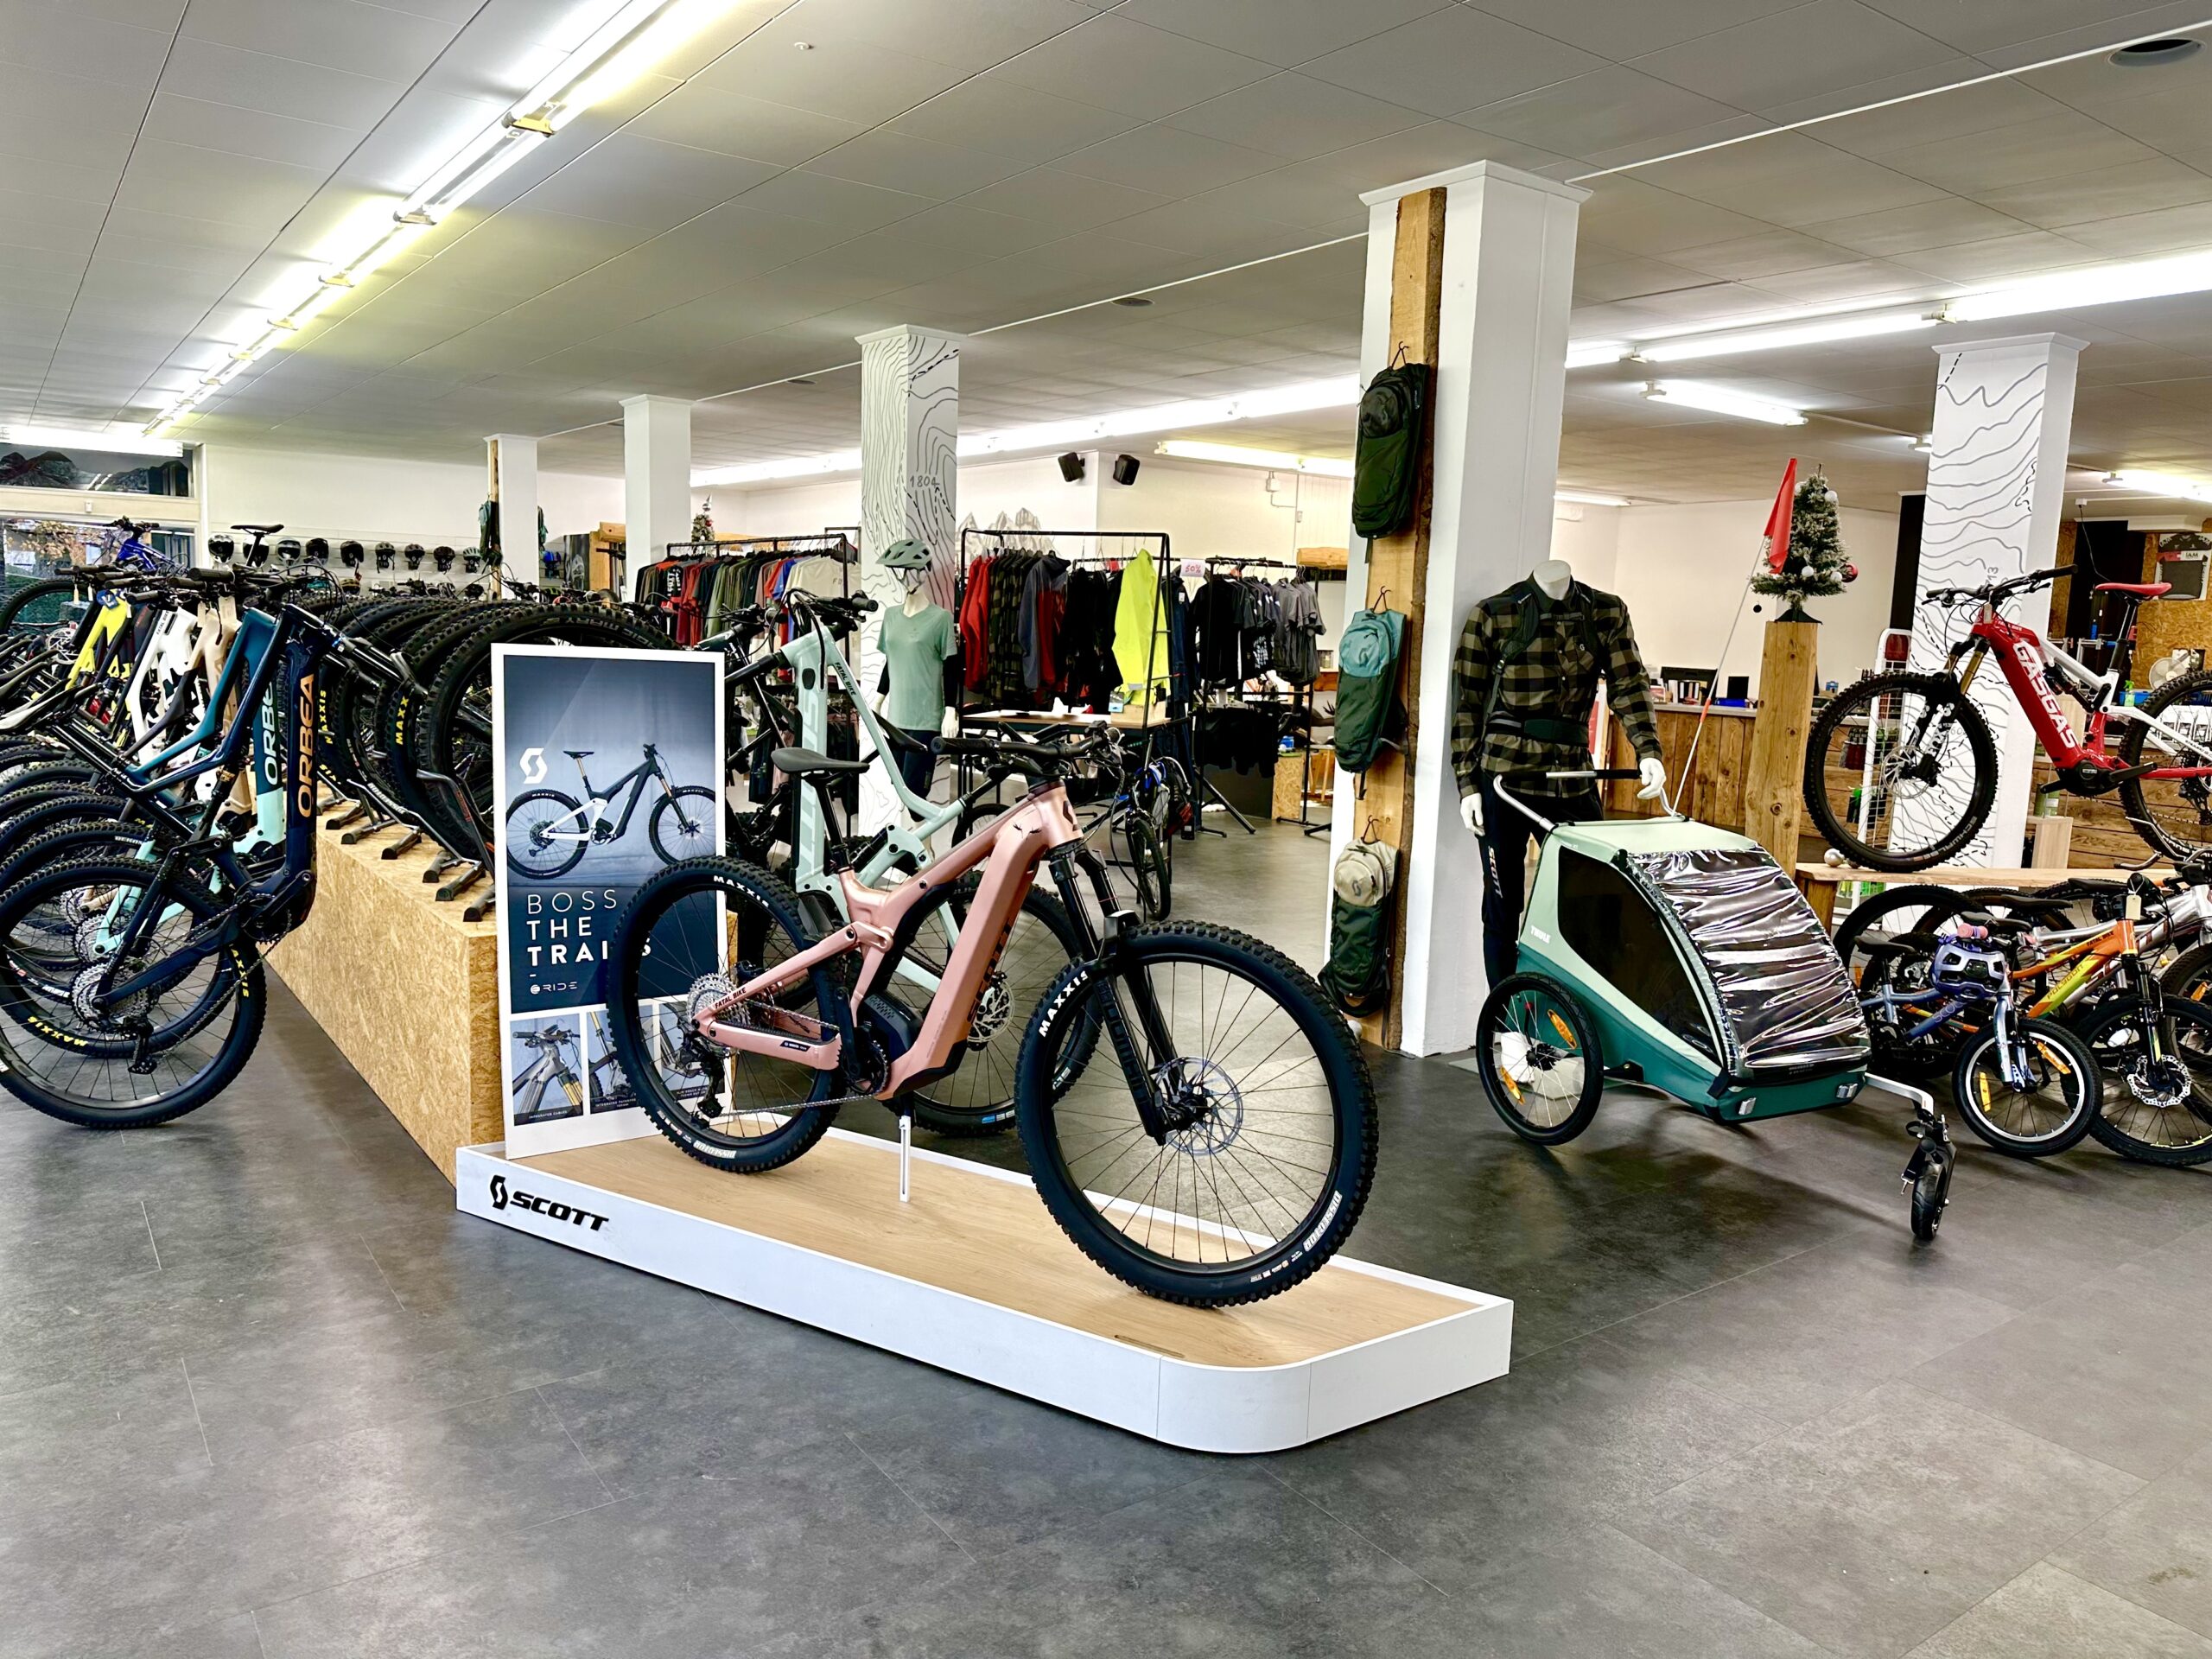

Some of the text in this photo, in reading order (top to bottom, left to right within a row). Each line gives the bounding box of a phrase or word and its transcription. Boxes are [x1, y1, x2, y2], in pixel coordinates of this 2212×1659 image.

[910, 474, 941, 488] 1804
[1185, 563, 1202, 575] 50%
[835, 662, 856, 696] FATAL BIKE
[2012, 640, 2076, 749] GASGAS
[261, 681, 279, 786] ORBE
[395, 696, 410, 746] MAXX
[297, 673, 315, 818] ORBEA
[1488, 846, 1503, 899] SCOTT
[527, 889, 617, 914] BOSS
[713, 874, 770, 908] MAXXIS
[526, 916, 592, 940] THE
[1530, 925, 1552, 944] THULE
[2086, 930, 2114, 947] FATAL BIKE
[230, 948, 250, 998] AXXIS
[715, 987, 747, 1009] FATAL BIKE
[1038, 969, 1089, 1038] MAXXIS
[27, 1015, 89, 1047] MAXXIS
[693, 1139, 737, 1160] DISSECTOR
[509, 1190, 610, 1232] SCOTT
[1302, 1189, 1344, 1253] DISSECTOR
